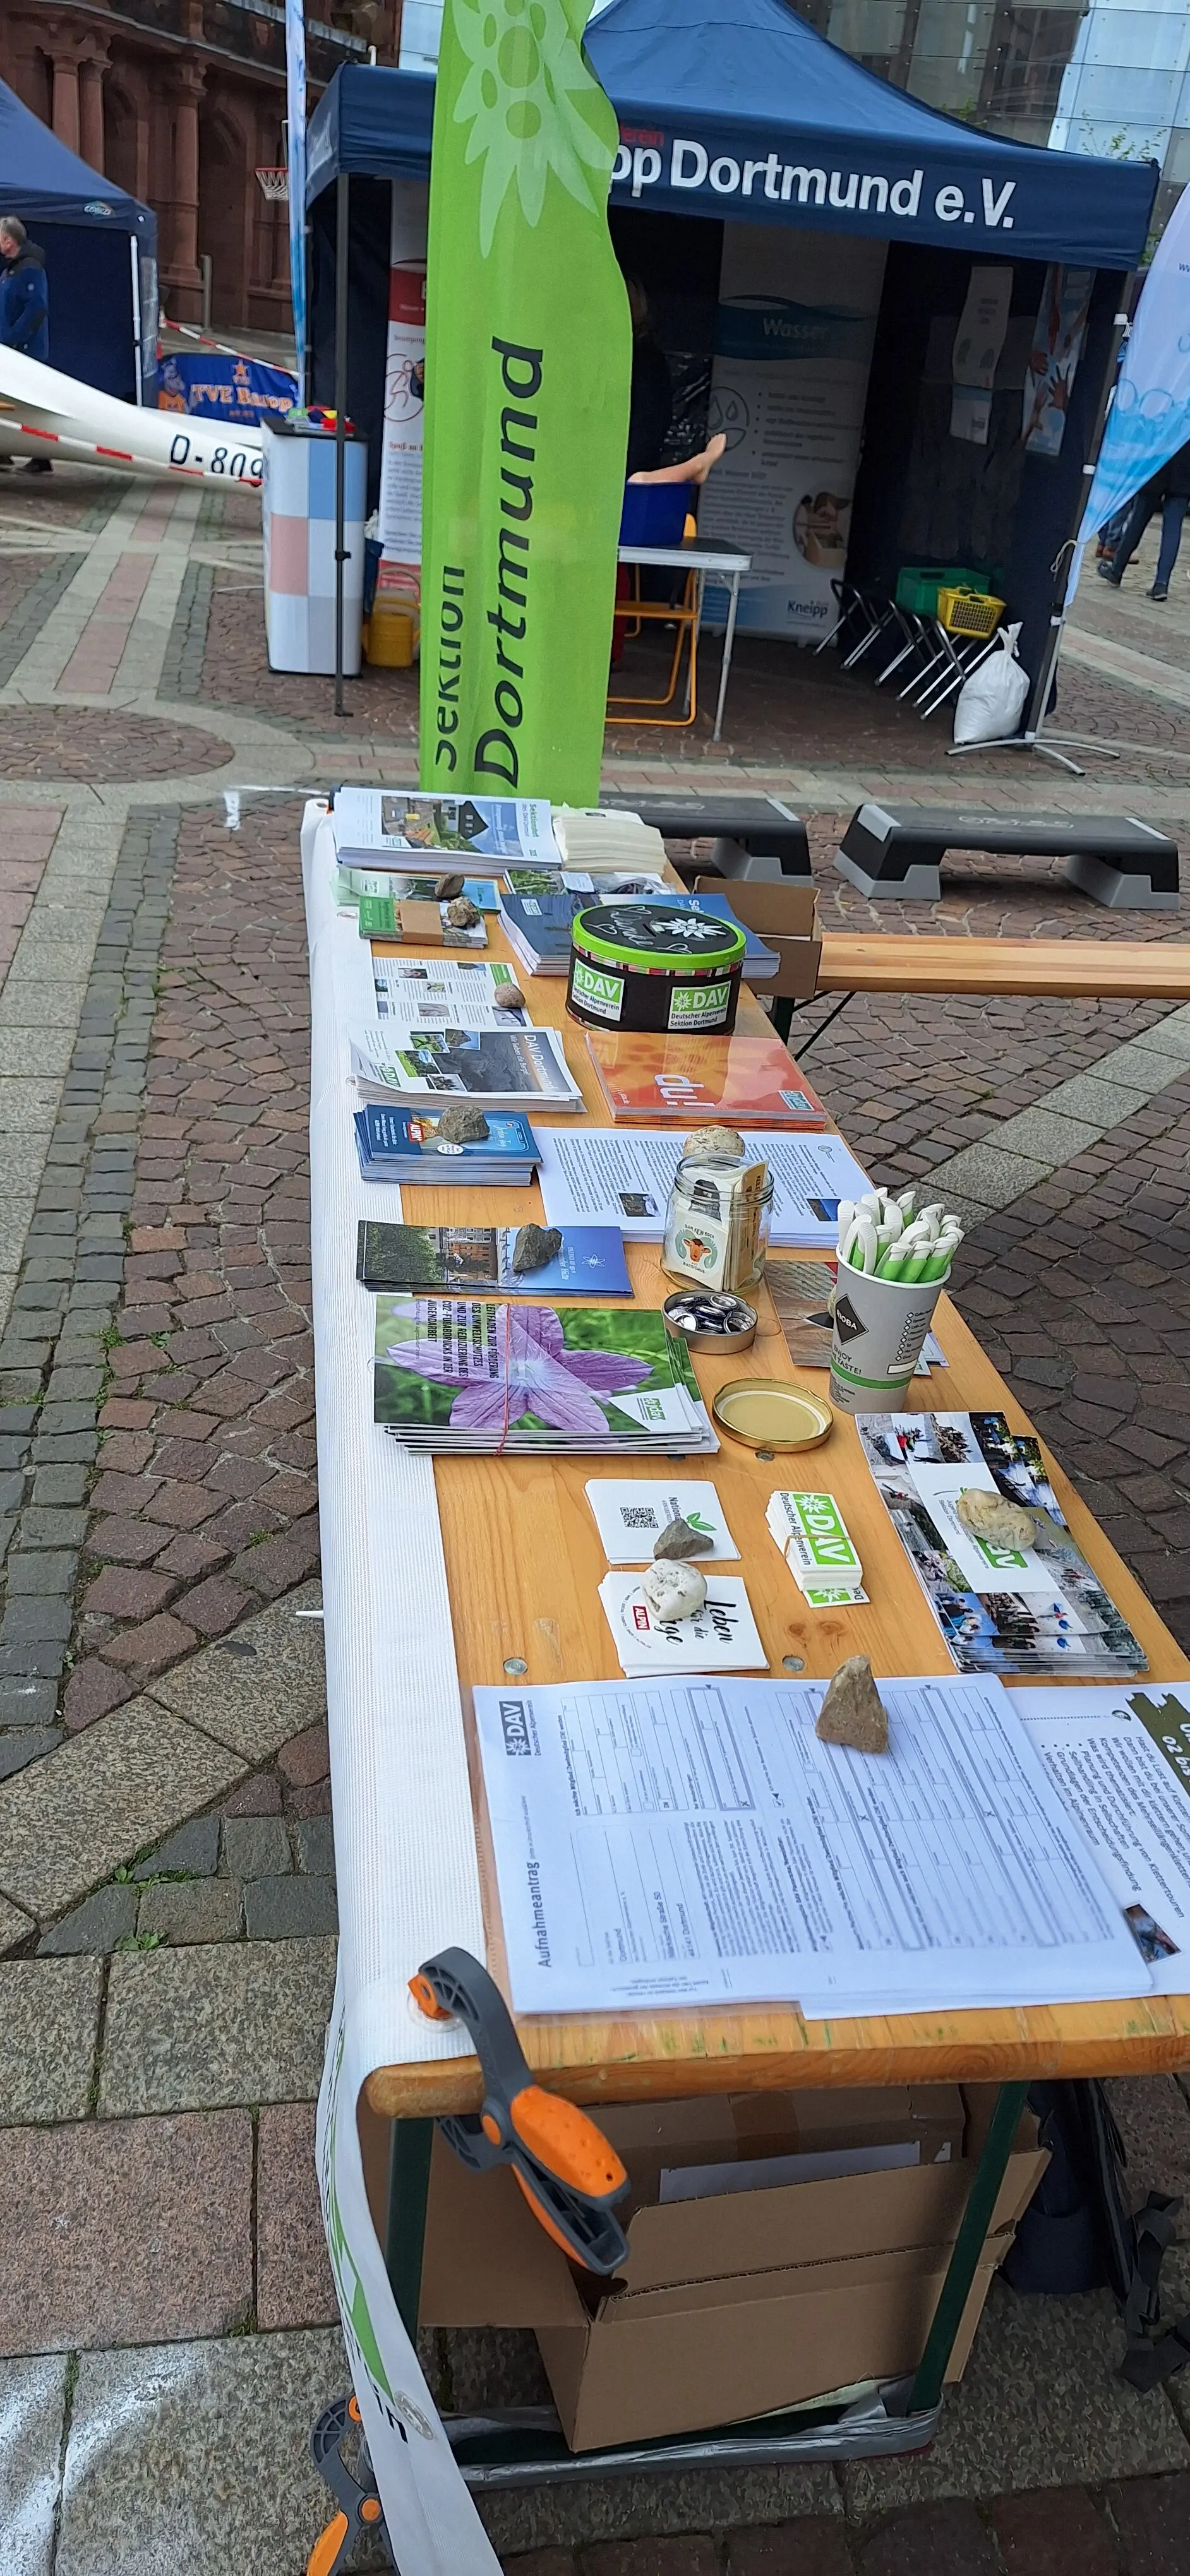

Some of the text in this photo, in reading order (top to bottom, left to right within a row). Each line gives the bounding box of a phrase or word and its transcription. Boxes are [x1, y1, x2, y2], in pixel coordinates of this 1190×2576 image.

[670, 138, 925, 217] Dortmund
[935, 177, 1017, 229] e.V.
[763, 318, 829, 340] Wasser
[191, 384, 294, 413] TVE Barop
[474, 335, 543, 789] Dortmund
[788, 600, 828, 618] Kneipp
[584, 973, 619, 999] DAV
[692, 987, 728, 1008] DAV
[584, 999, 606, 1015] Dortmund
[589, 995, 620, 1011] Alpenverein
[701, 1007, 727, 1018] Alpenverein
[693, 1017, 718, 1026] Dortmund
[524, 1035, 559, 1089] DAV Dortmund
[654, 1074, 716, 1107] du!
[428, 1300, 437, 1342] JUGENDARBEIT
[472, 1303, 483, 1366] DES UMWELTSCHUTZES
[836, 1309, 857, 1330] RIOBA
[457, 1302, 468, 1377] UND ZUR REDUZIERUNG DES
[486, 1303, 499, 1378] LEITFADEN ZUR FÖRDERUNG
[834, 1344, 853, 1362] ENJOY
[443, 1363, 453, 1373] DER
[838, 1357, 862, 1375] TASTE!
[642, 1404, 666, 1421] jdav
[780, 1493, 796, 1524] Deutscher
[939, 1500, 949, 1515] Sektion
[805, 1515, 851, 1563] DAV
[634, 1607, 647, 1629] ALPIN
[694, 1626, 709, 1640] die
[704, 1599, 739, 1644] Leben
[503, 1703, 525, 1737] DAV
[526, 1700, 541, 1756] Deutscher Alpenverein
[1087, 1738, 1099, 1753] Was
[1096, 1753, 1110, 1770] wird
[1162, 1736, 1183, 1754] 02
[1100, 1738, 1131, 1786] Kompetenzen
[1127, 1786, 1139, 1801] des
[1124, 1736, 1138, 1755] Dann
[1135, 1756, 1148, 1770] bist
[1144, 1771, 1155, 1782] du
[1150, 1782, 1163, 1794] bei
[1158, 1794, 1179, 1823] unserer
[1136, 1736, 1150, 1753] Hast
[1146, 1751, 1156, 1763] du
[1153, 1763, 1167, 1780] Lust
[1163, 1781, 1177, 1794] auf
[1044, 1751, 1067, 1787] Verhalten
[1062, 1787, 1073, 1797] im
[1070, 1797, 1100, 1846] Alpinenraum
[1069, 1751, 1129, 1849] Seilhandling in Seilschaften
[1112, 1737, 1123, 1750] Wir
[1119, 1750, 1136, 1774] wollen
[1133, 1775, 1145, 1788] mit
[1141, 1788, 1152, 1799] dir
[1148, 1799, 1170, 1830] klettern
[1056, 1751, 1142, 1892] Grundlagen der Entscheidungsfindung
[1080, 1750, 1184, 1918] Planung und Durchführung von Klettertouren
[527, 1861, 552, 1968] Aufnahmeantrag
